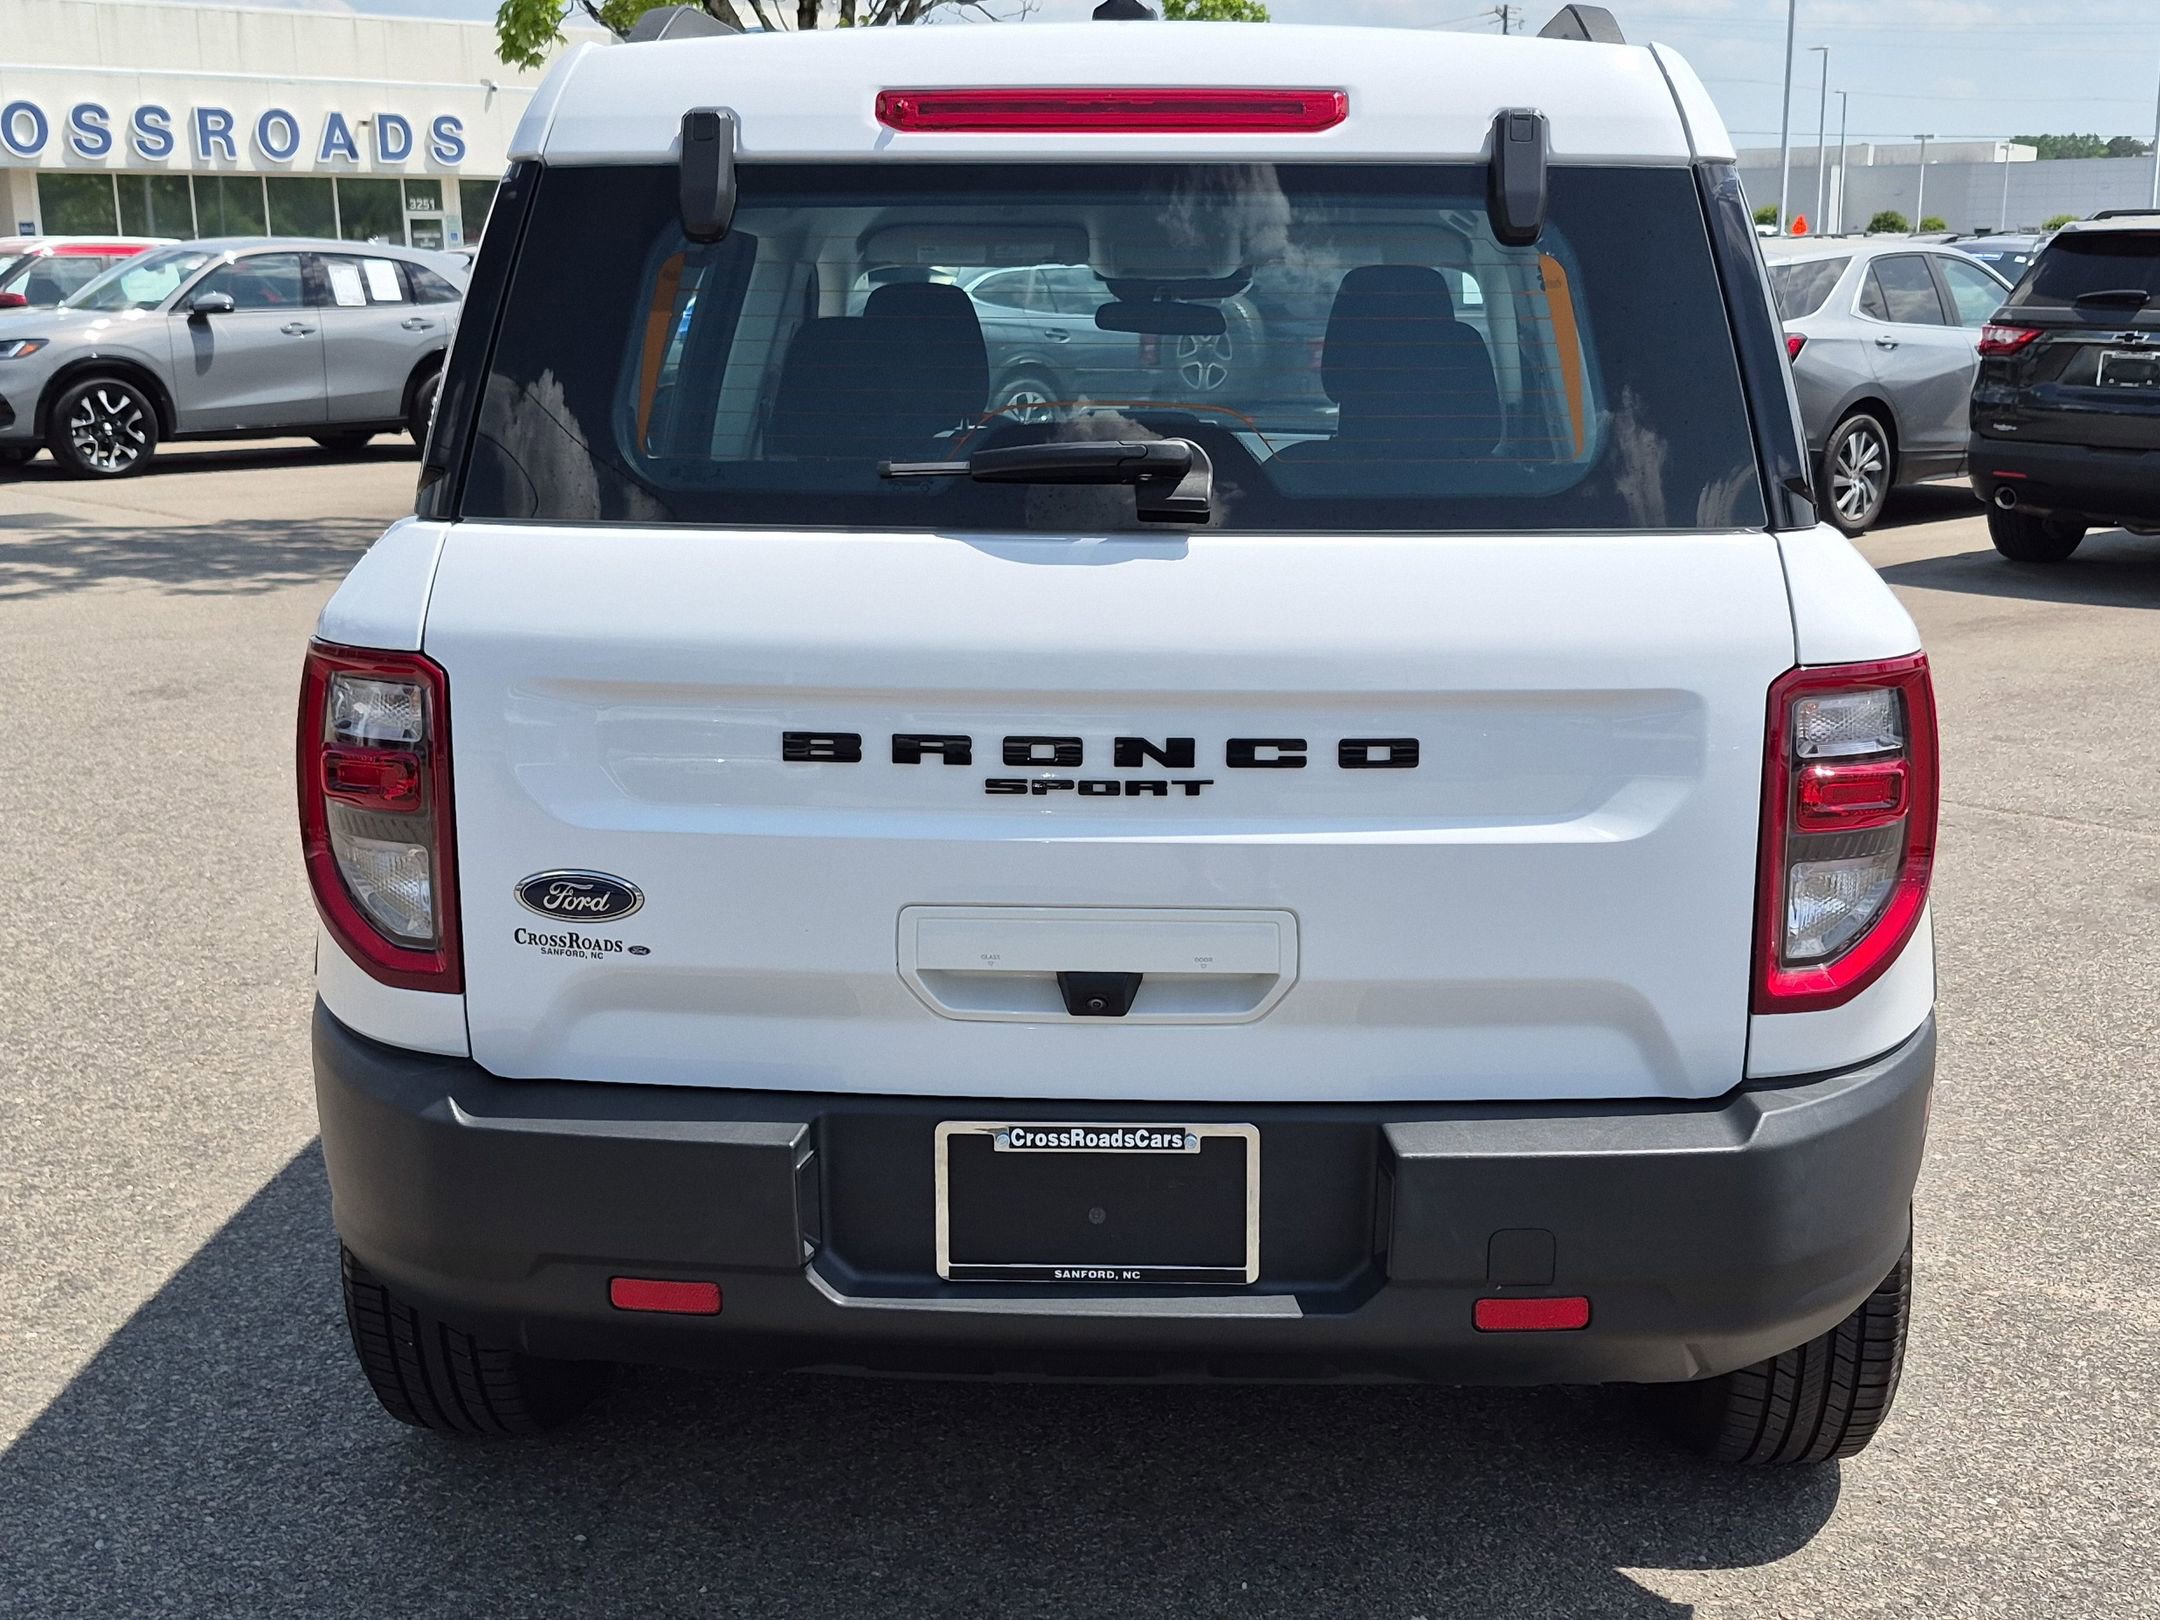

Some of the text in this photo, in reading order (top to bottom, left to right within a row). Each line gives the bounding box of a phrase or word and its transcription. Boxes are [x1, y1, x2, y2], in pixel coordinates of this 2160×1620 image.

[0, 100, 467, 167] OSSROADS
[409, 198, 435, 210] 3251
[782, 731, 1420, 769] BRONCO
[984, 778, 1214, 797] SPORT
[543, 881, 611, 912] Ford
[541, 947, 604, 959] SANFORD, NC
[1010, 1128, 1183, 1148] CrossRoadsCars
[1054, 1269, 1141, 1281] SANFORD, NC
